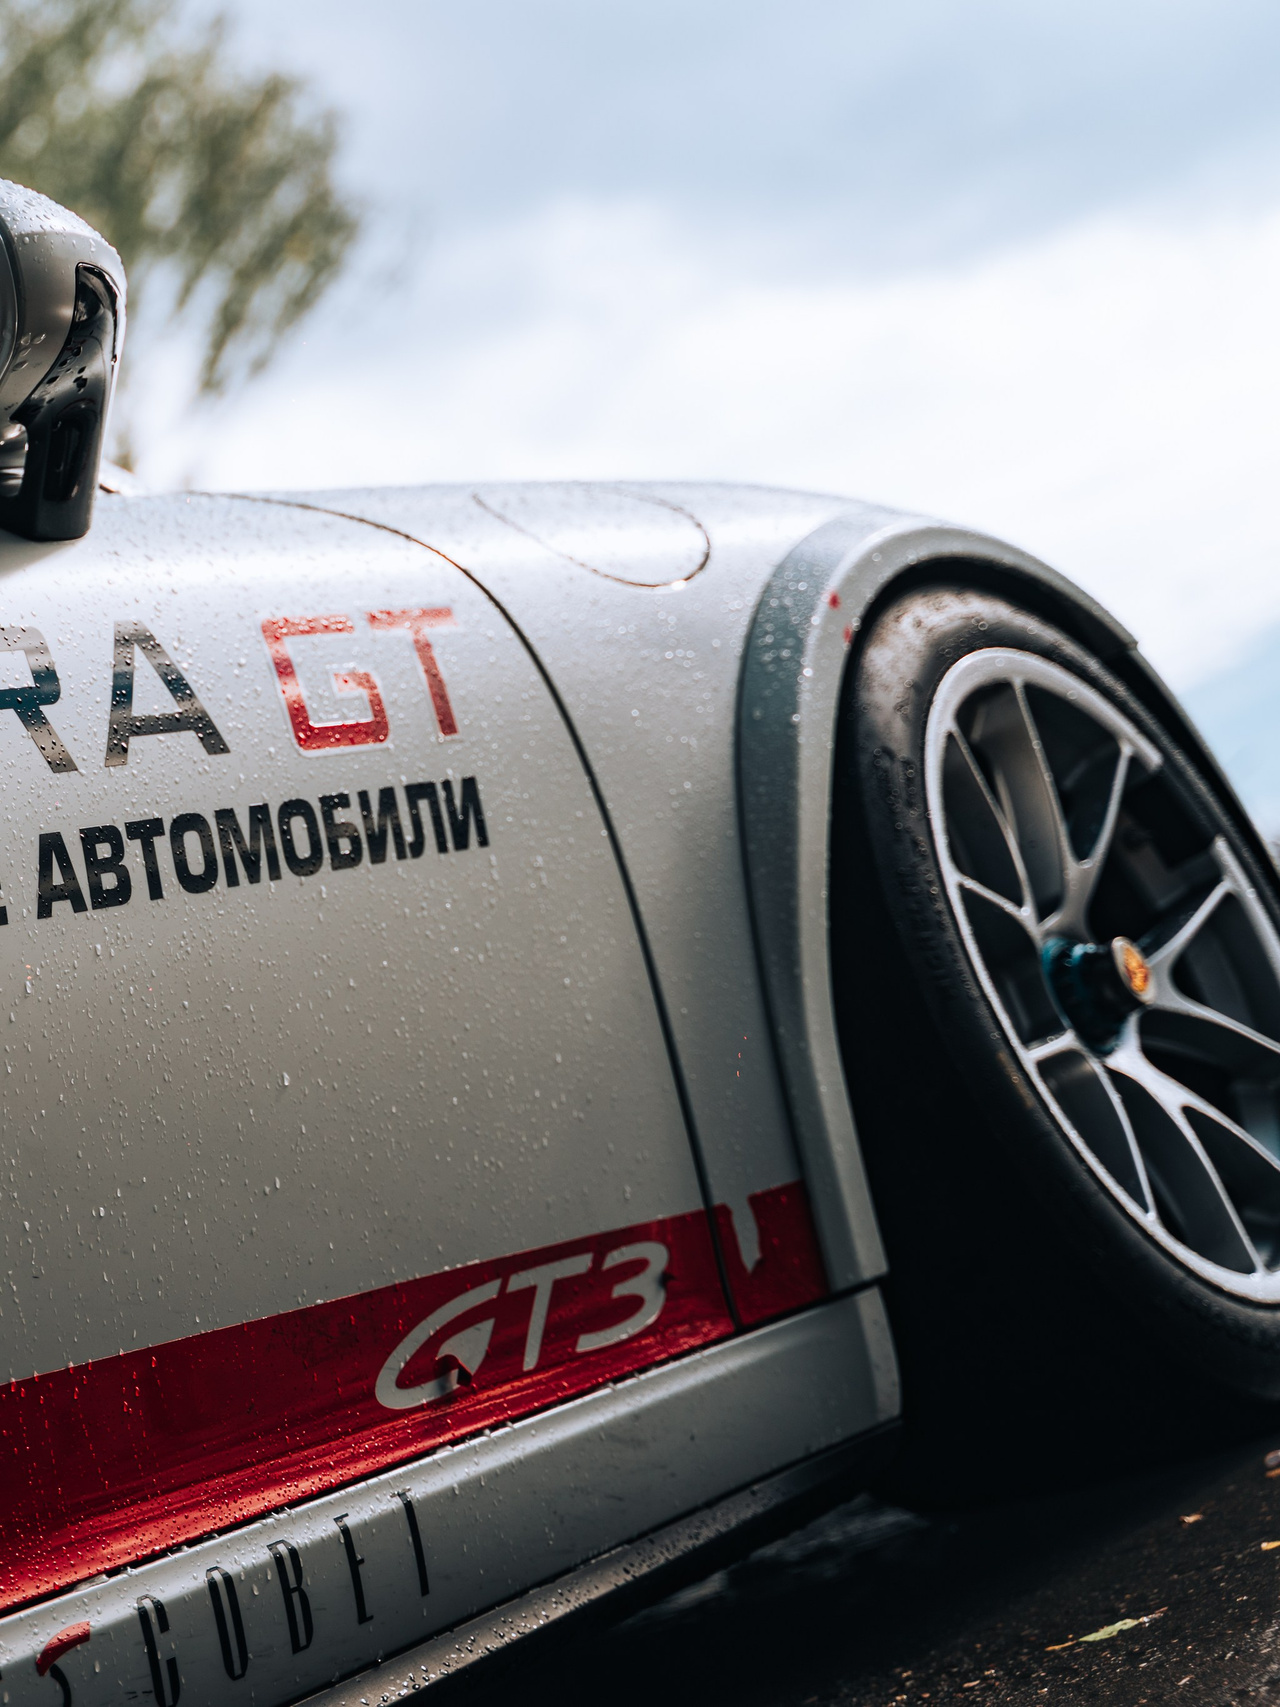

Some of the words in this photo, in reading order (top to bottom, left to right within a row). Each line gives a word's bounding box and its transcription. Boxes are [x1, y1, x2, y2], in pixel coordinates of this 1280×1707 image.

[261, 606, 460, 756] GT
[36, 775, 490, 920] АВТОМОБИЛИ
[375, 1240, 670, 1410] GT3
